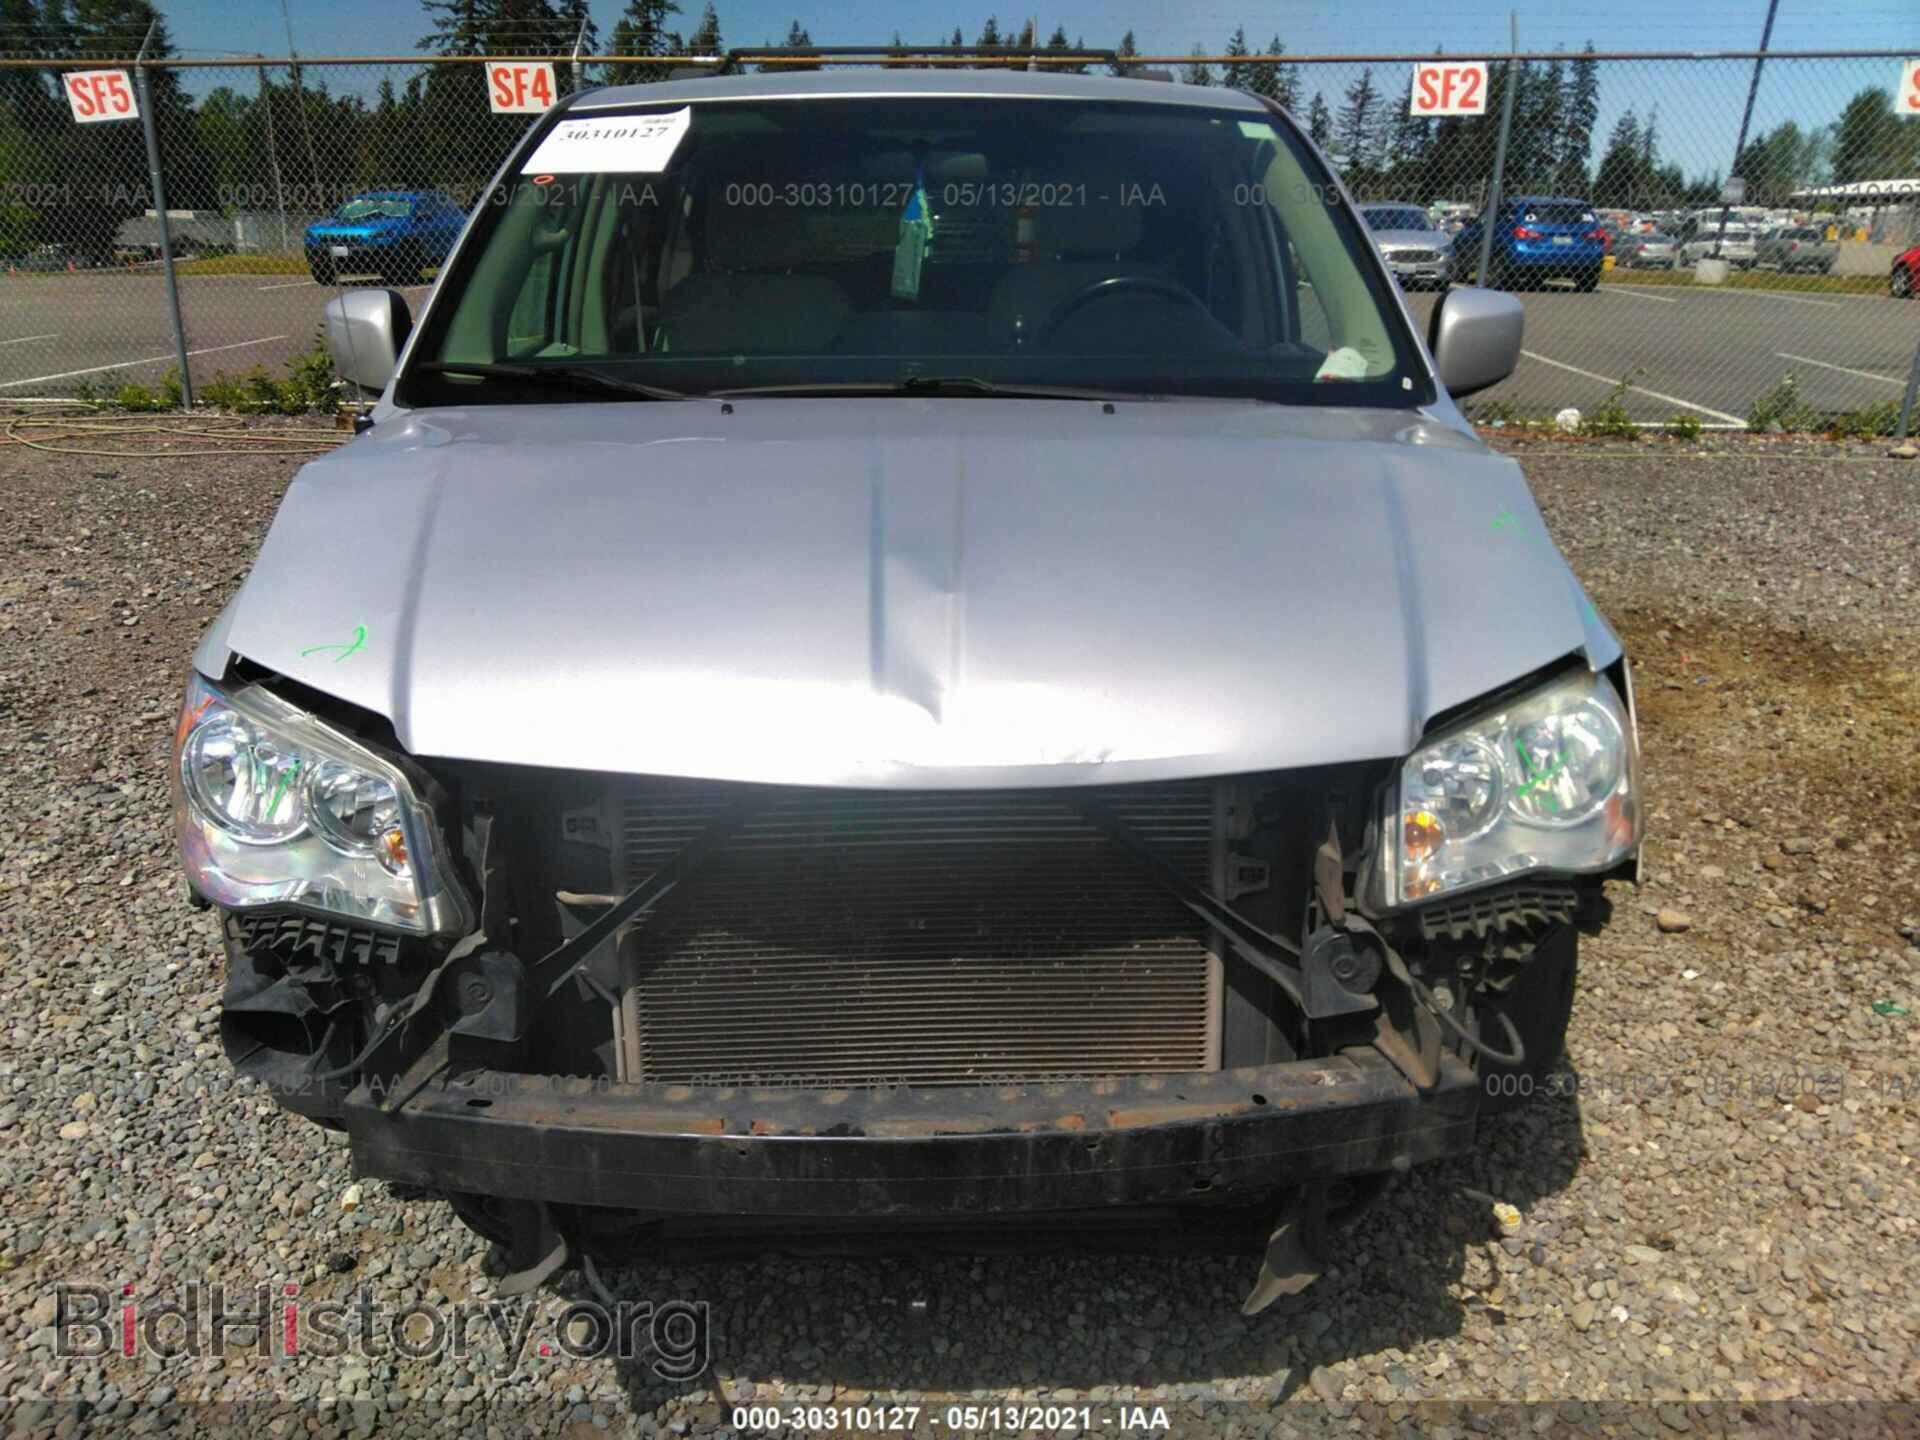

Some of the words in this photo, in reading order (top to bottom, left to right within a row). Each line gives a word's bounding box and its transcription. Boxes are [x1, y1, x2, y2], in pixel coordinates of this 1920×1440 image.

[69, 74, 130, 116] SF5
[492, 67, 552, 108] SF4
[1417, 68, 1481, 110] SF2
